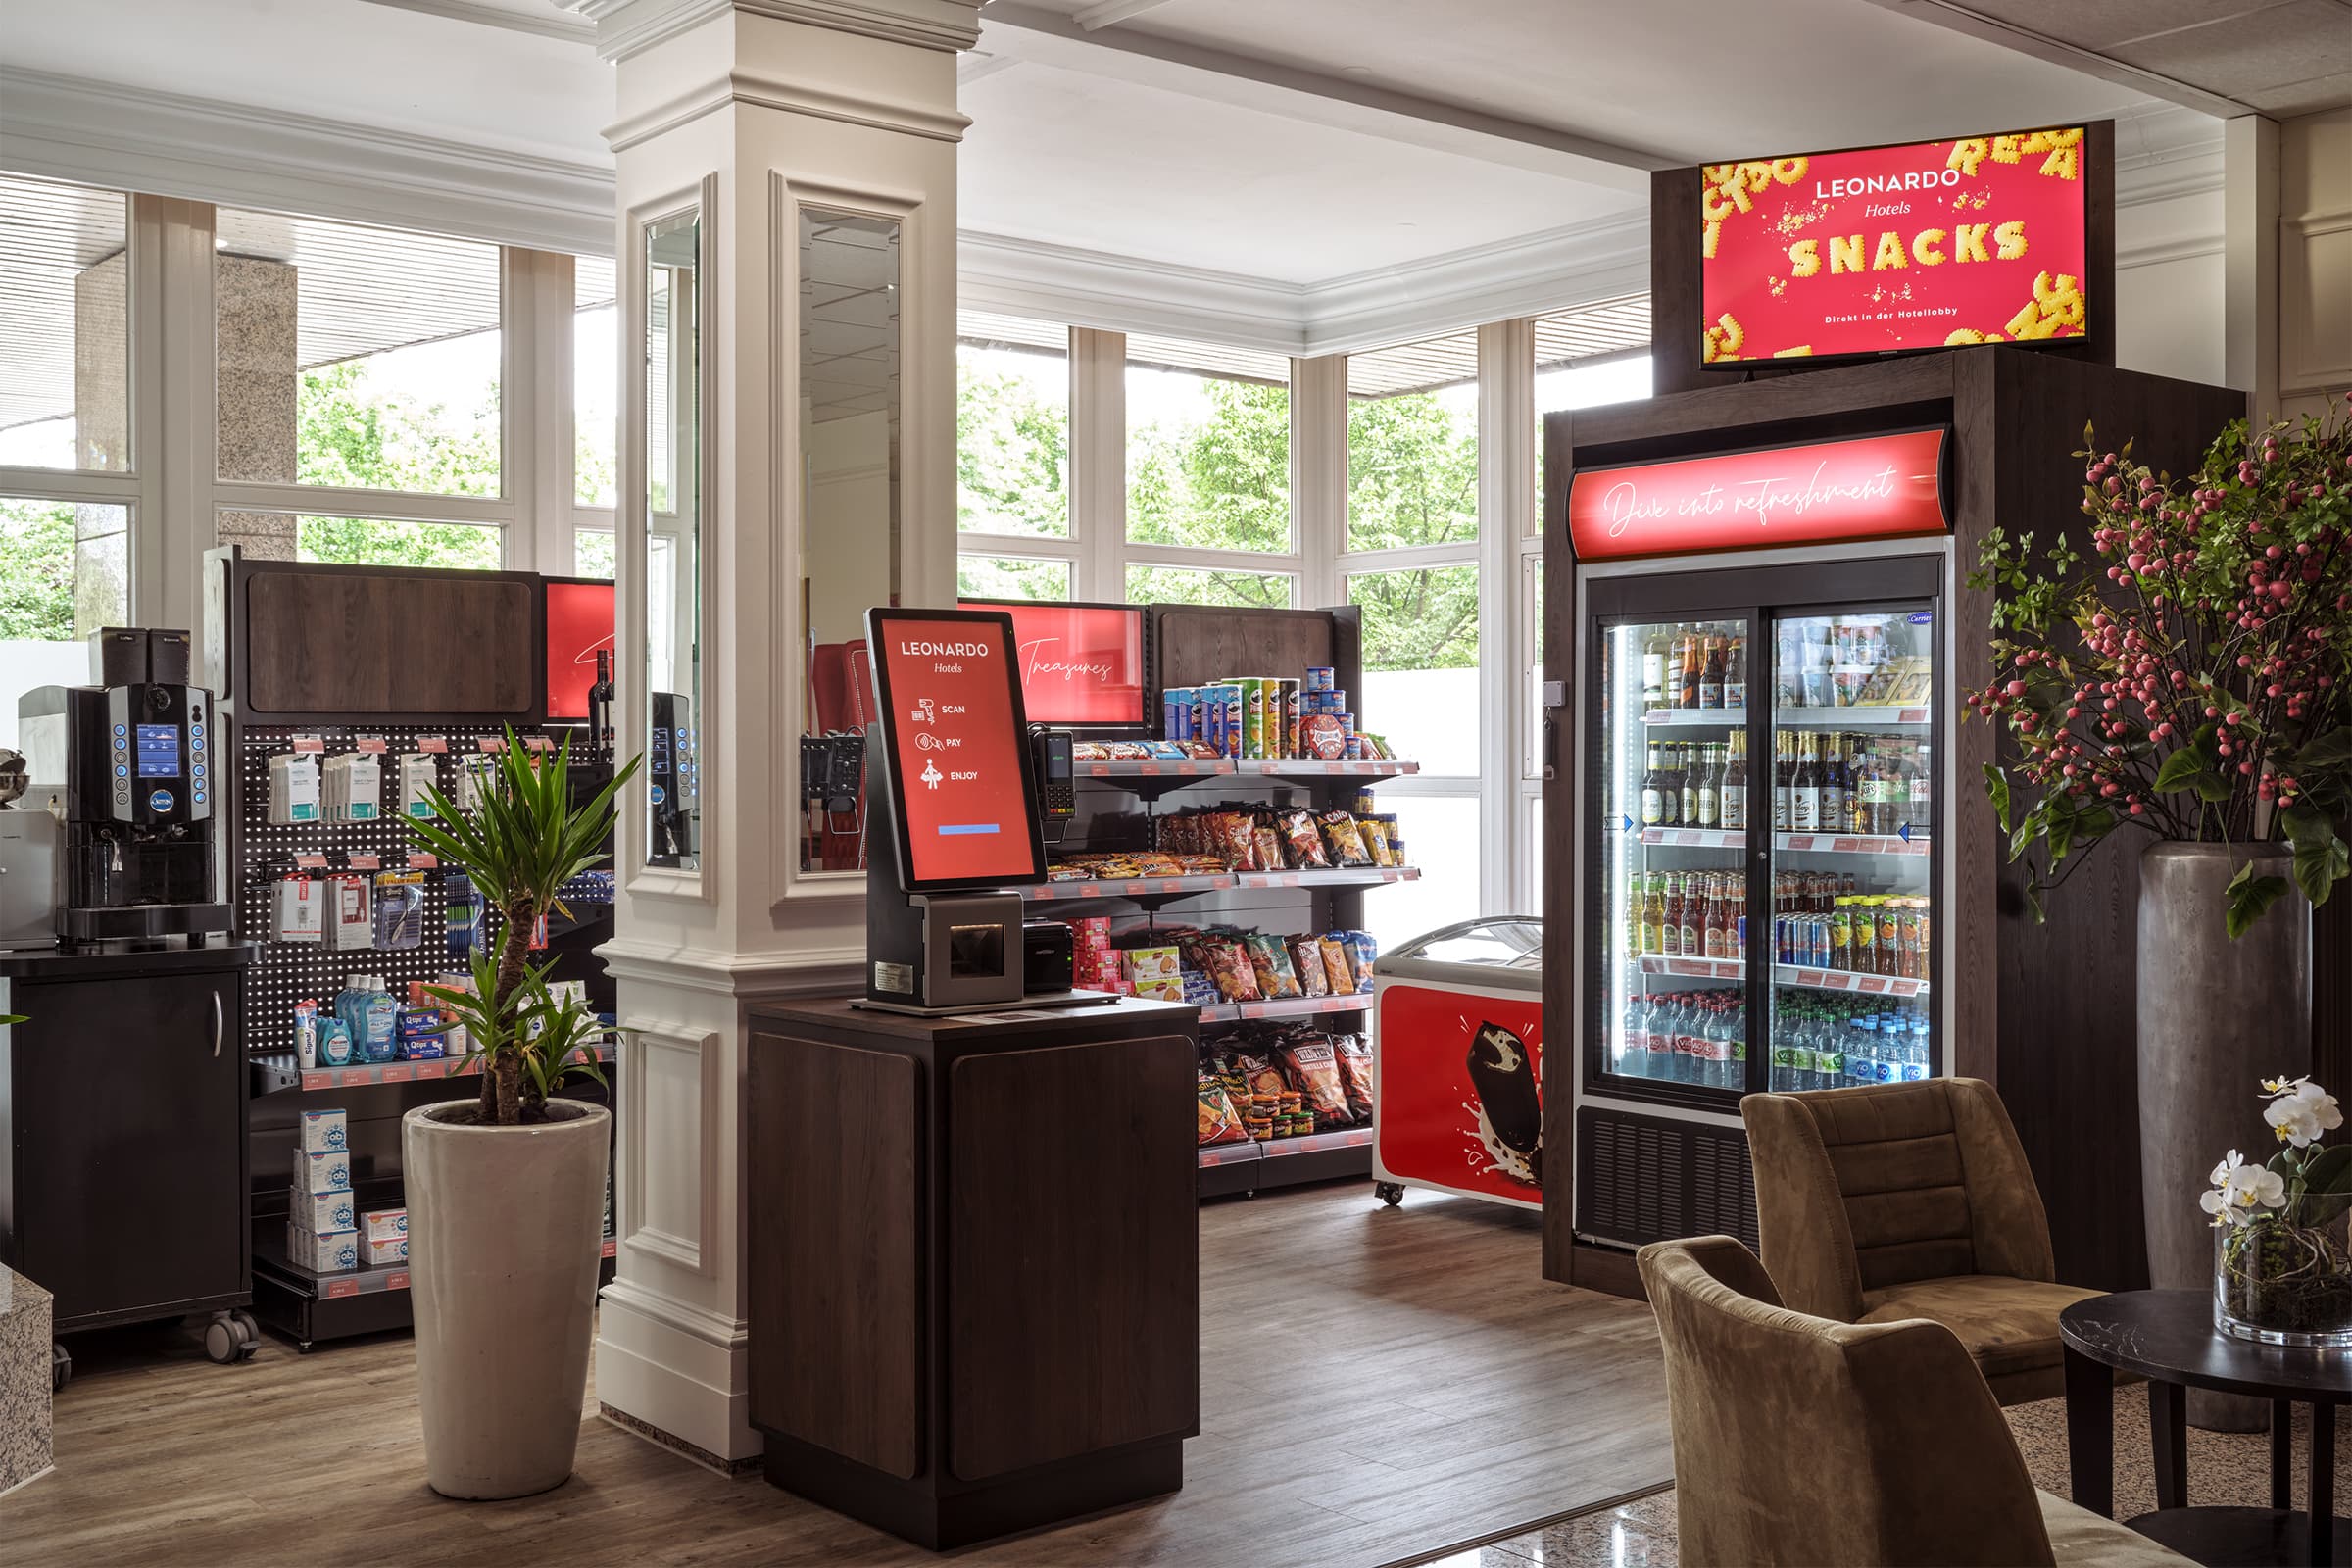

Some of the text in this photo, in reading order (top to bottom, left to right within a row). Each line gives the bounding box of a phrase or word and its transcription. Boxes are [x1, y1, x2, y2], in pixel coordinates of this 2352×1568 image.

[1816, 168, 1960, 199] LEONARDO
[1864, 201, 1912, 219] Hotels
[1788, 220, 2030, 278] SNACKS
[1825, 313, 1858, 324] Direkt
[1876, 310, 1893, 320] der
[1897, 306, 1958, 319] Hotellobby
[1603, 461, 1898, 538] Dive into refreshment
[901, 641, 989, 658] LEONARDO
[934, 662, 962, 674] Hotels
[1019, 637, 1112, 686] Treasures
[941, 705, 966, 714] SCAN
[946, 738, 962, 748] PAY
[950, 771, 978, 781] ENJOY
[1326, 809, 1348, 824] Chio
